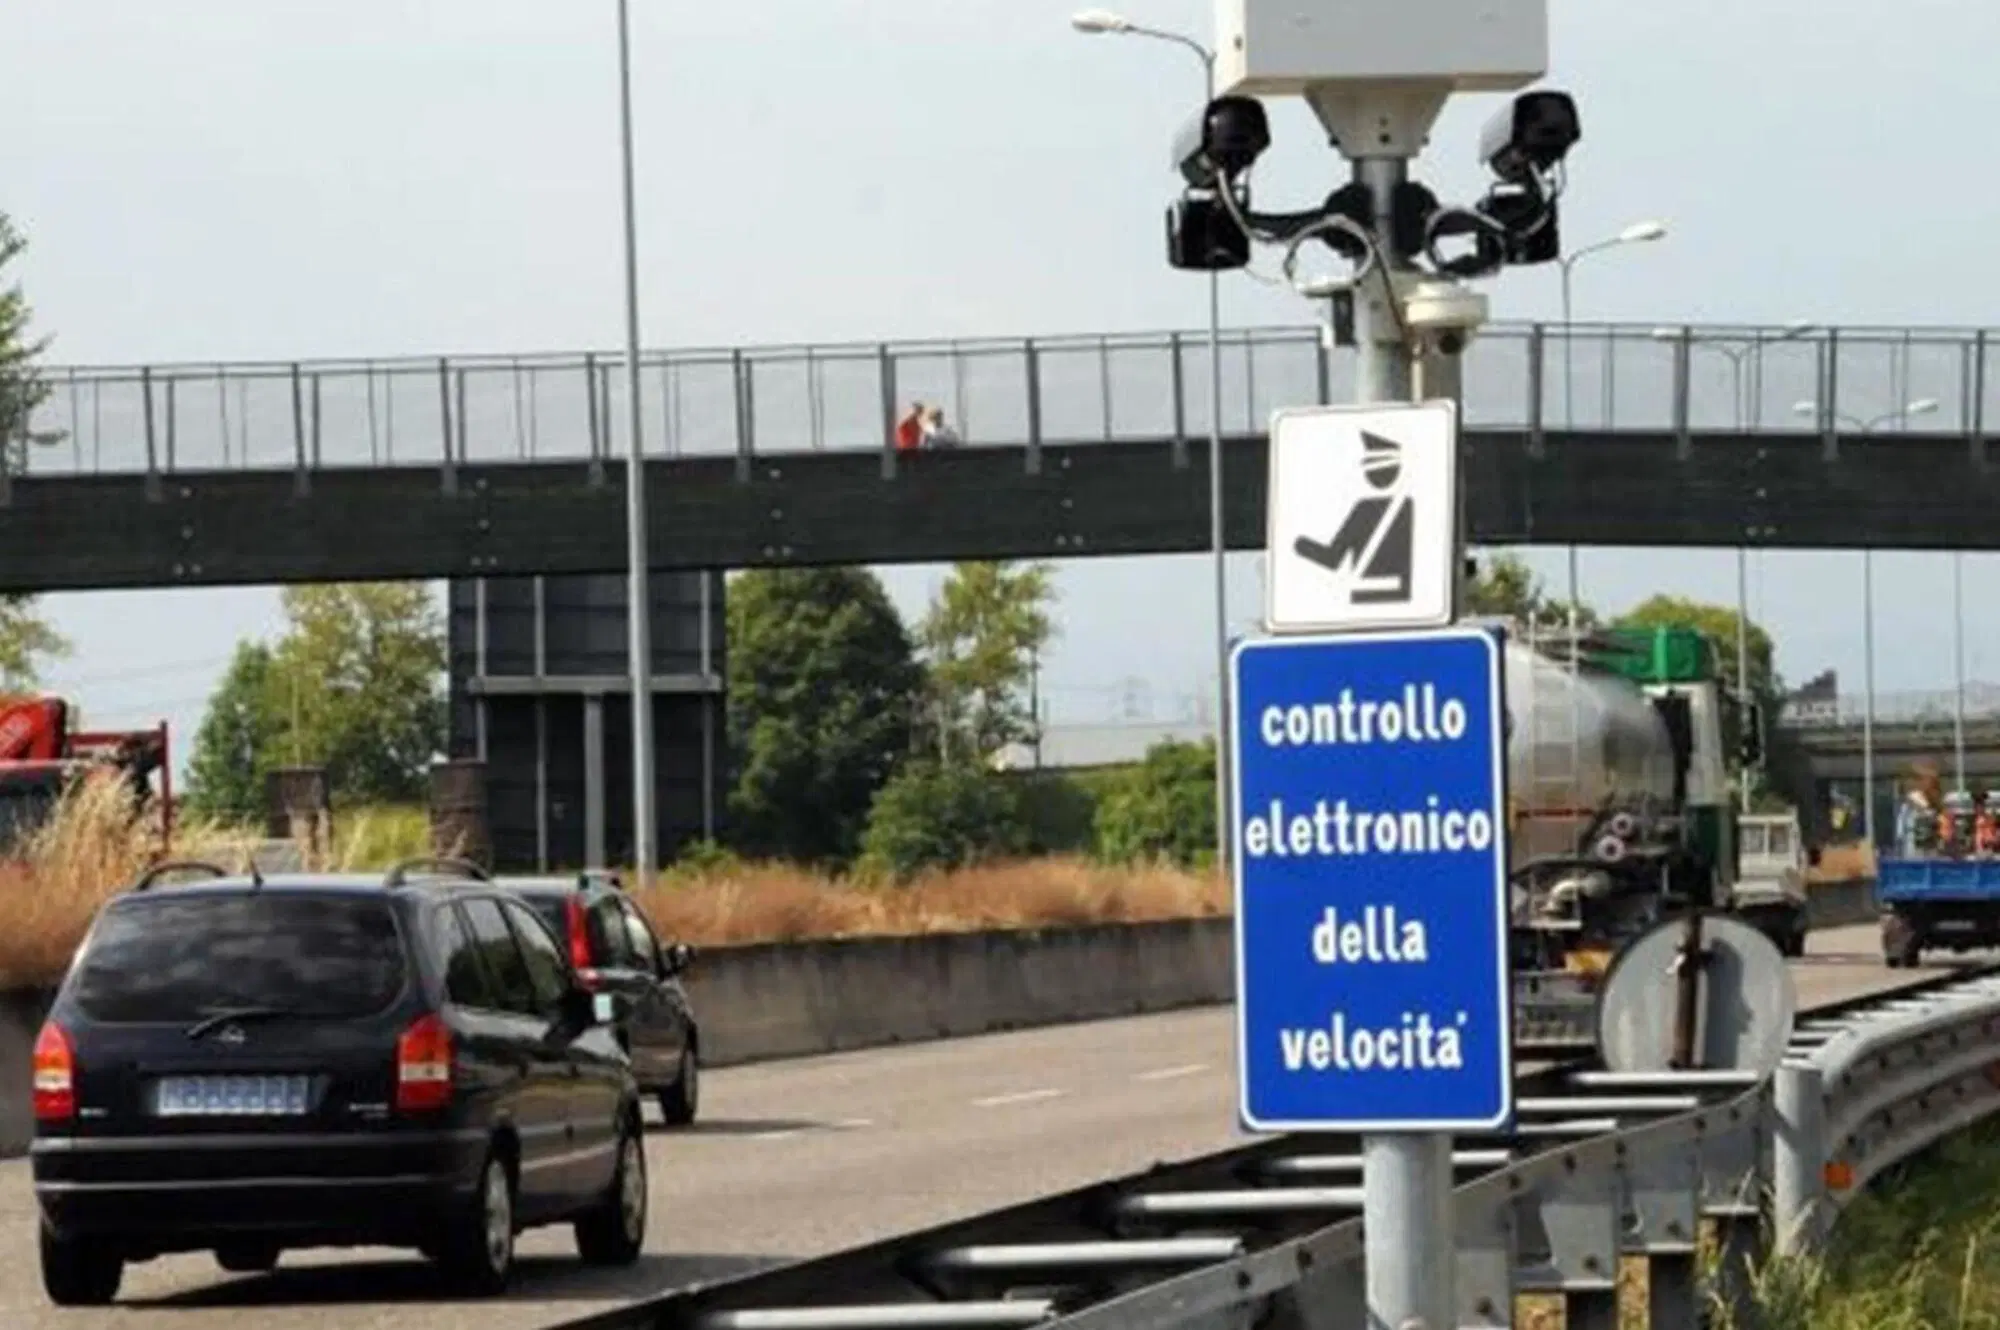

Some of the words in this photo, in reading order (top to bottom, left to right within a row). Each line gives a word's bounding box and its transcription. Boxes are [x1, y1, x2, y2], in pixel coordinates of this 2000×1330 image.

[1260, 683, 1467, 746] controllo
[1244, 796, 1492, 856] elettronico
[1312, 905, 1427, 964] della
